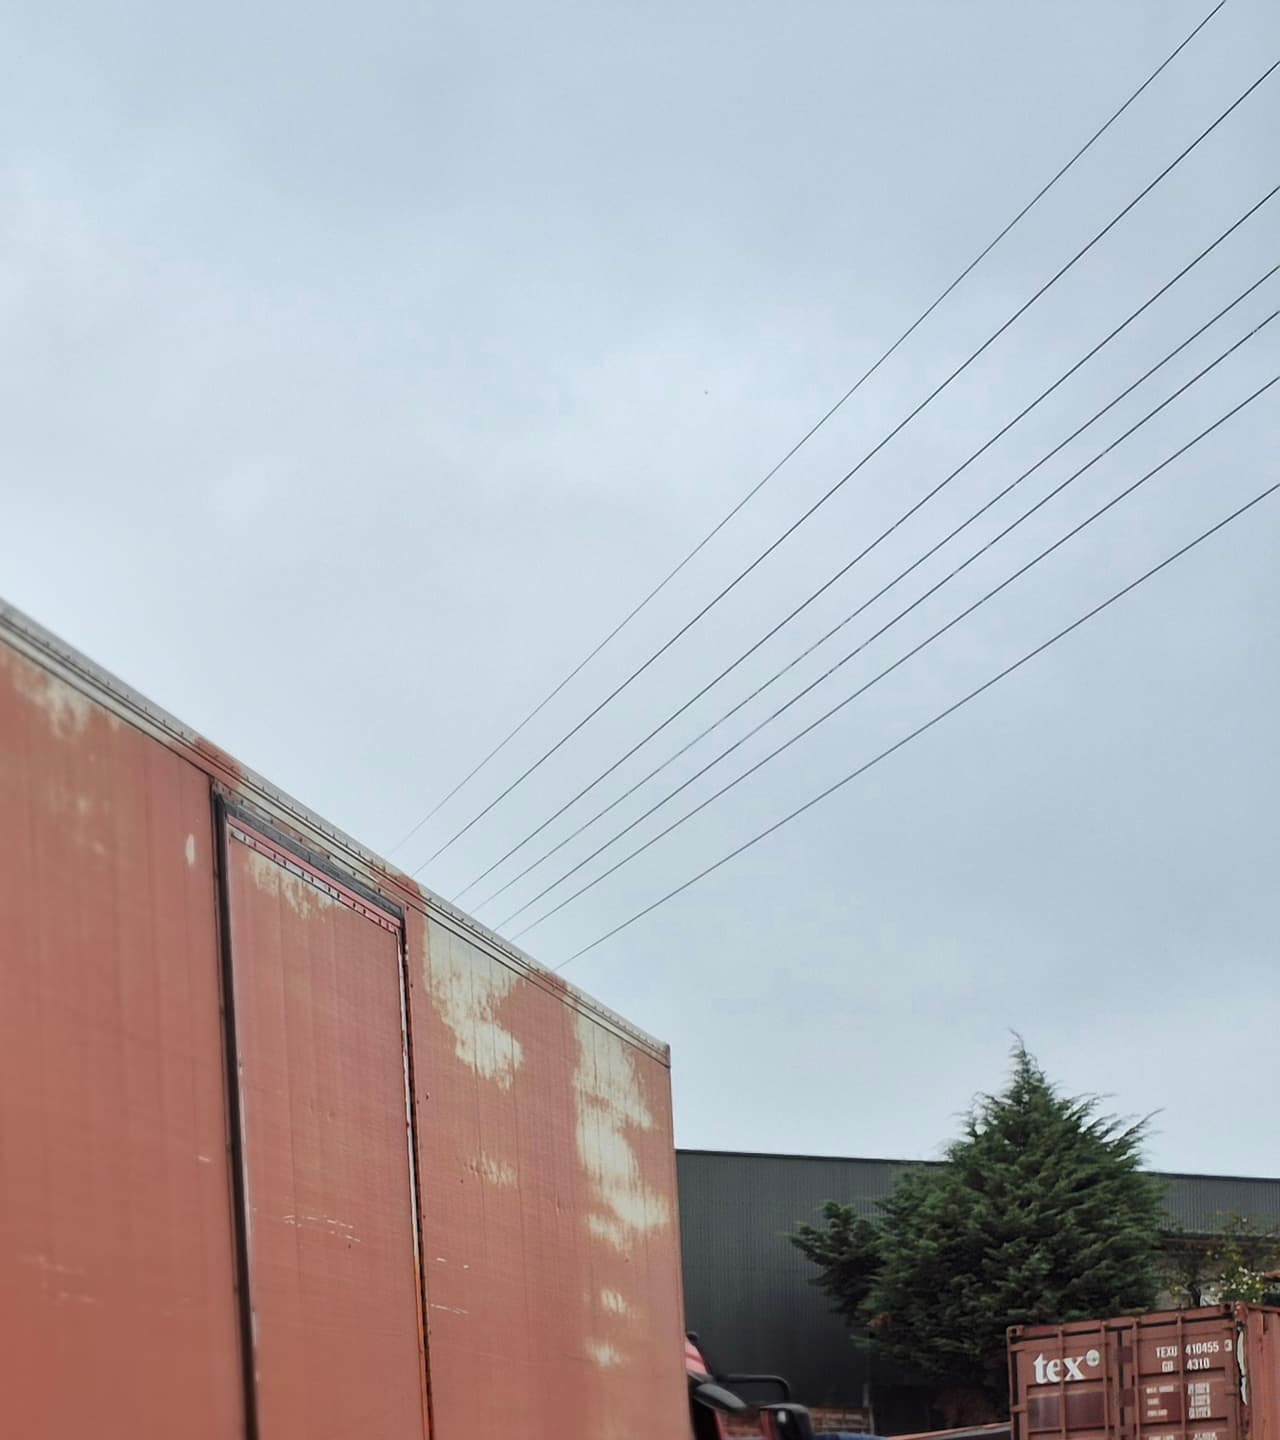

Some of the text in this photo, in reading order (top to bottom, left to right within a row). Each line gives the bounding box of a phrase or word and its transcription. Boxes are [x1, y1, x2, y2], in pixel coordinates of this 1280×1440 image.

[1155, 1345, 1178, 1358] TEXU
[1185, 1341, 1219, 1356] 410455
[1033, 1352, 1085, 1384] tex
[1186, 1357, 1210, 1371] 4310
